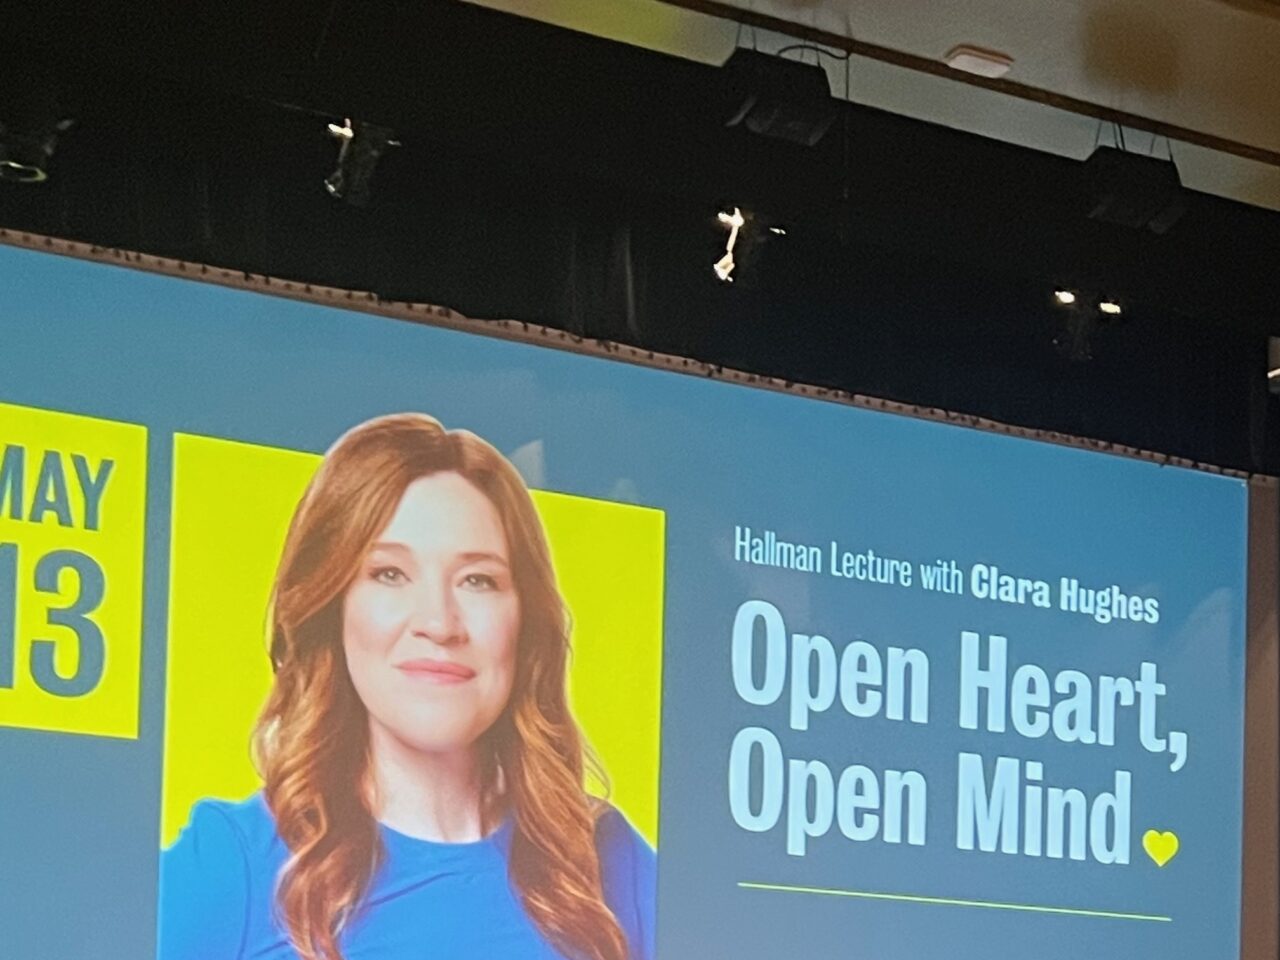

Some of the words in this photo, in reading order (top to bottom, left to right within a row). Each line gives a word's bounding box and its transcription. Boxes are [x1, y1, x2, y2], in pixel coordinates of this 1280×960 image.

[734, 526, 821, 573] Hallman
[831, 541, 912, 587] Lecture
[920, 559, 963, 595] with
[971, 563, 1051, 608] Clara
[1060, 577, 1160, 624] Hughes
[731, 600, 929, 731] Open
[959, 631, 1189, 773] Heart,
[728, 727, 926, 857] Open
